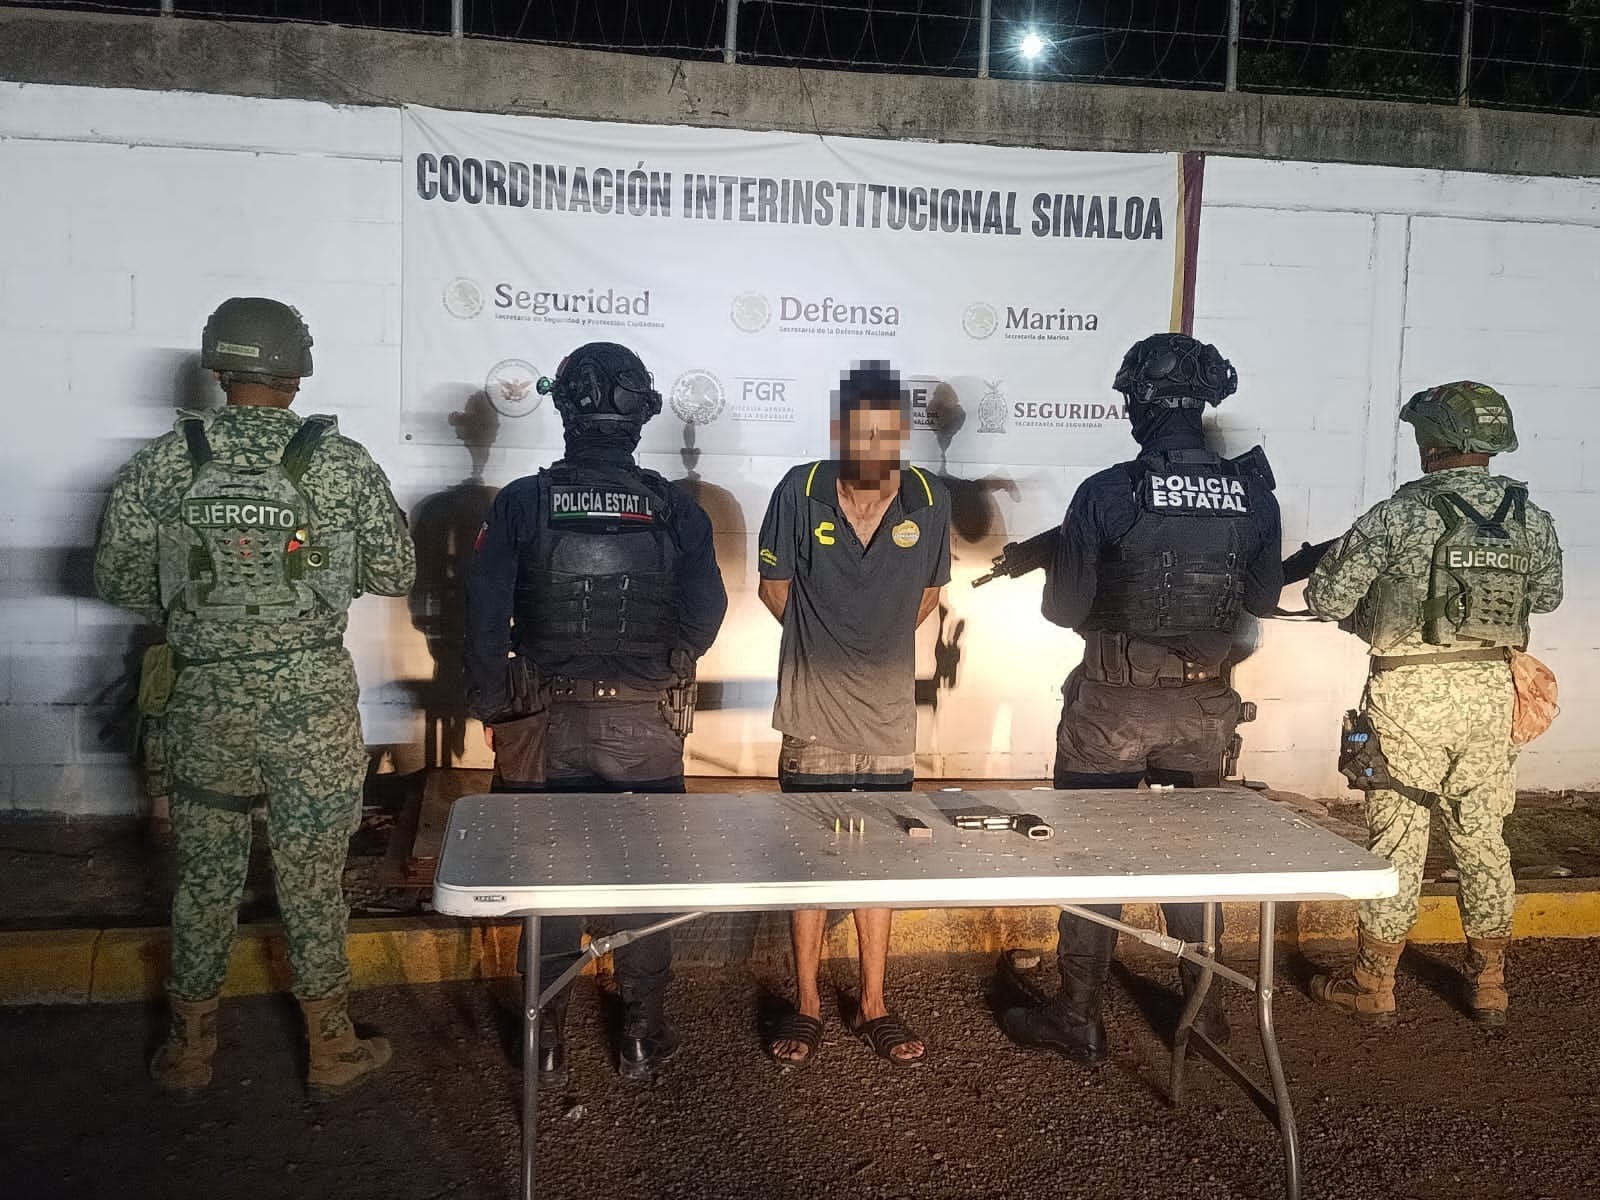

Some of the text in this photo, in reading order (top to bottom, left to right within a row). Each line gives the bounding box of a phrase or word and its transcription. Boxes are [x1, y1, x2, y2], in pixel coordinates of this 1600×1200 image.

[416, 152, 1163, 241] COORDINACIÓN INTERINSTITUCIONAL SINALOA
[494, 283, 650, 316] Seguridad
[780, 296, 900, 326] Defensa
[1005, 306, 1099, 331] Marina
[742, 381, 786, 402] FGR
[553, 488, 652, 516] POLICÍA ESTATL
[1152, 490, 1247, 512] ESTATAL
[188, 502, 295, 528] EJÉRCITO
[1449, 548, 1529, 573] EJÉRCITO
